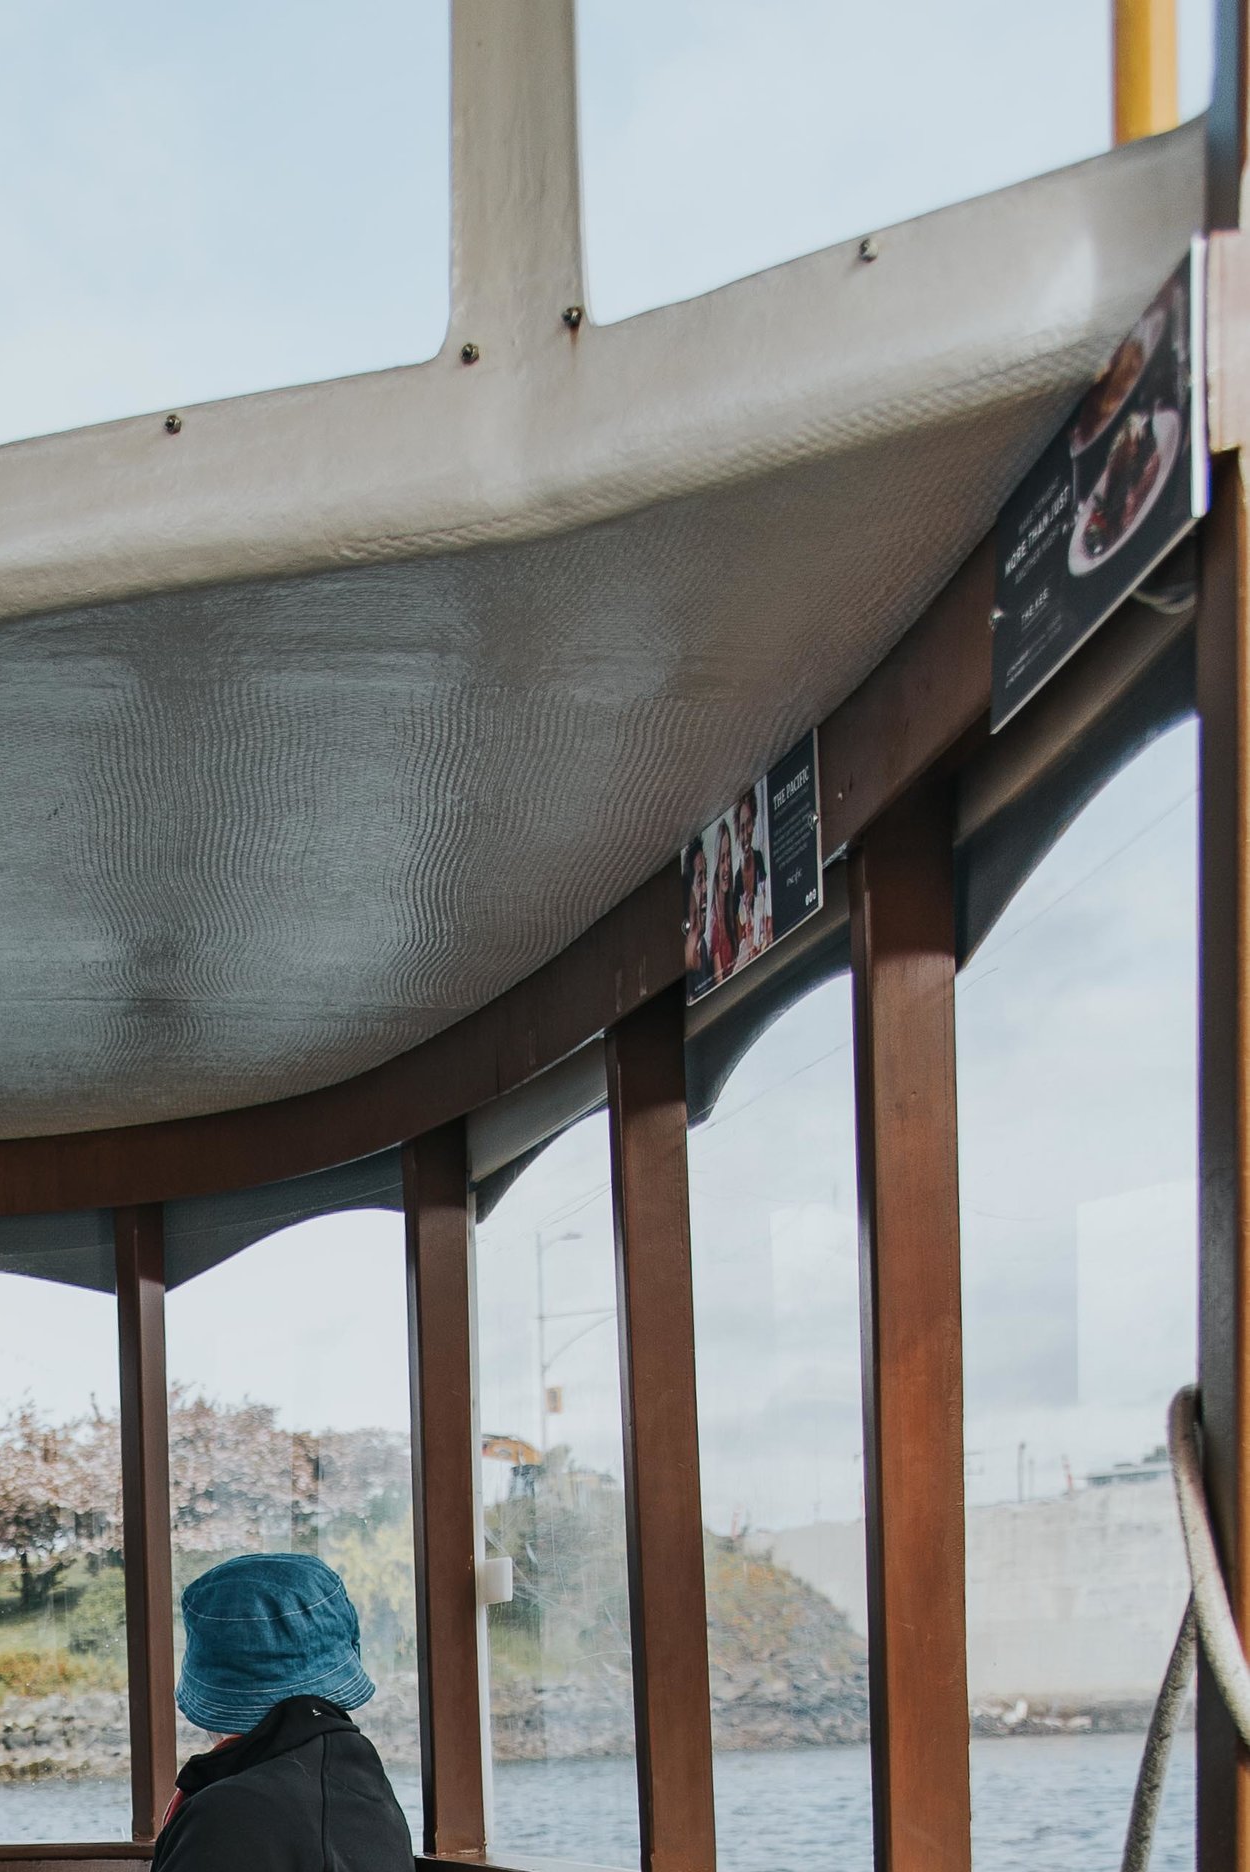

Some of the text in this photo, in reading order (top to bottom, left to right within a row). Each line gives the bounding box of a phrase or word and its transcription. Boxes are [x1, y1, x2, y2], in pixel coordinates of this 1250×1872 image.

[1027, 510, 1051, 550] THAN
[1049, 484, 1070, 525] JUST
[772, 787, 786, 811] THE
[785, 765, 811, 801] PACIFIC
